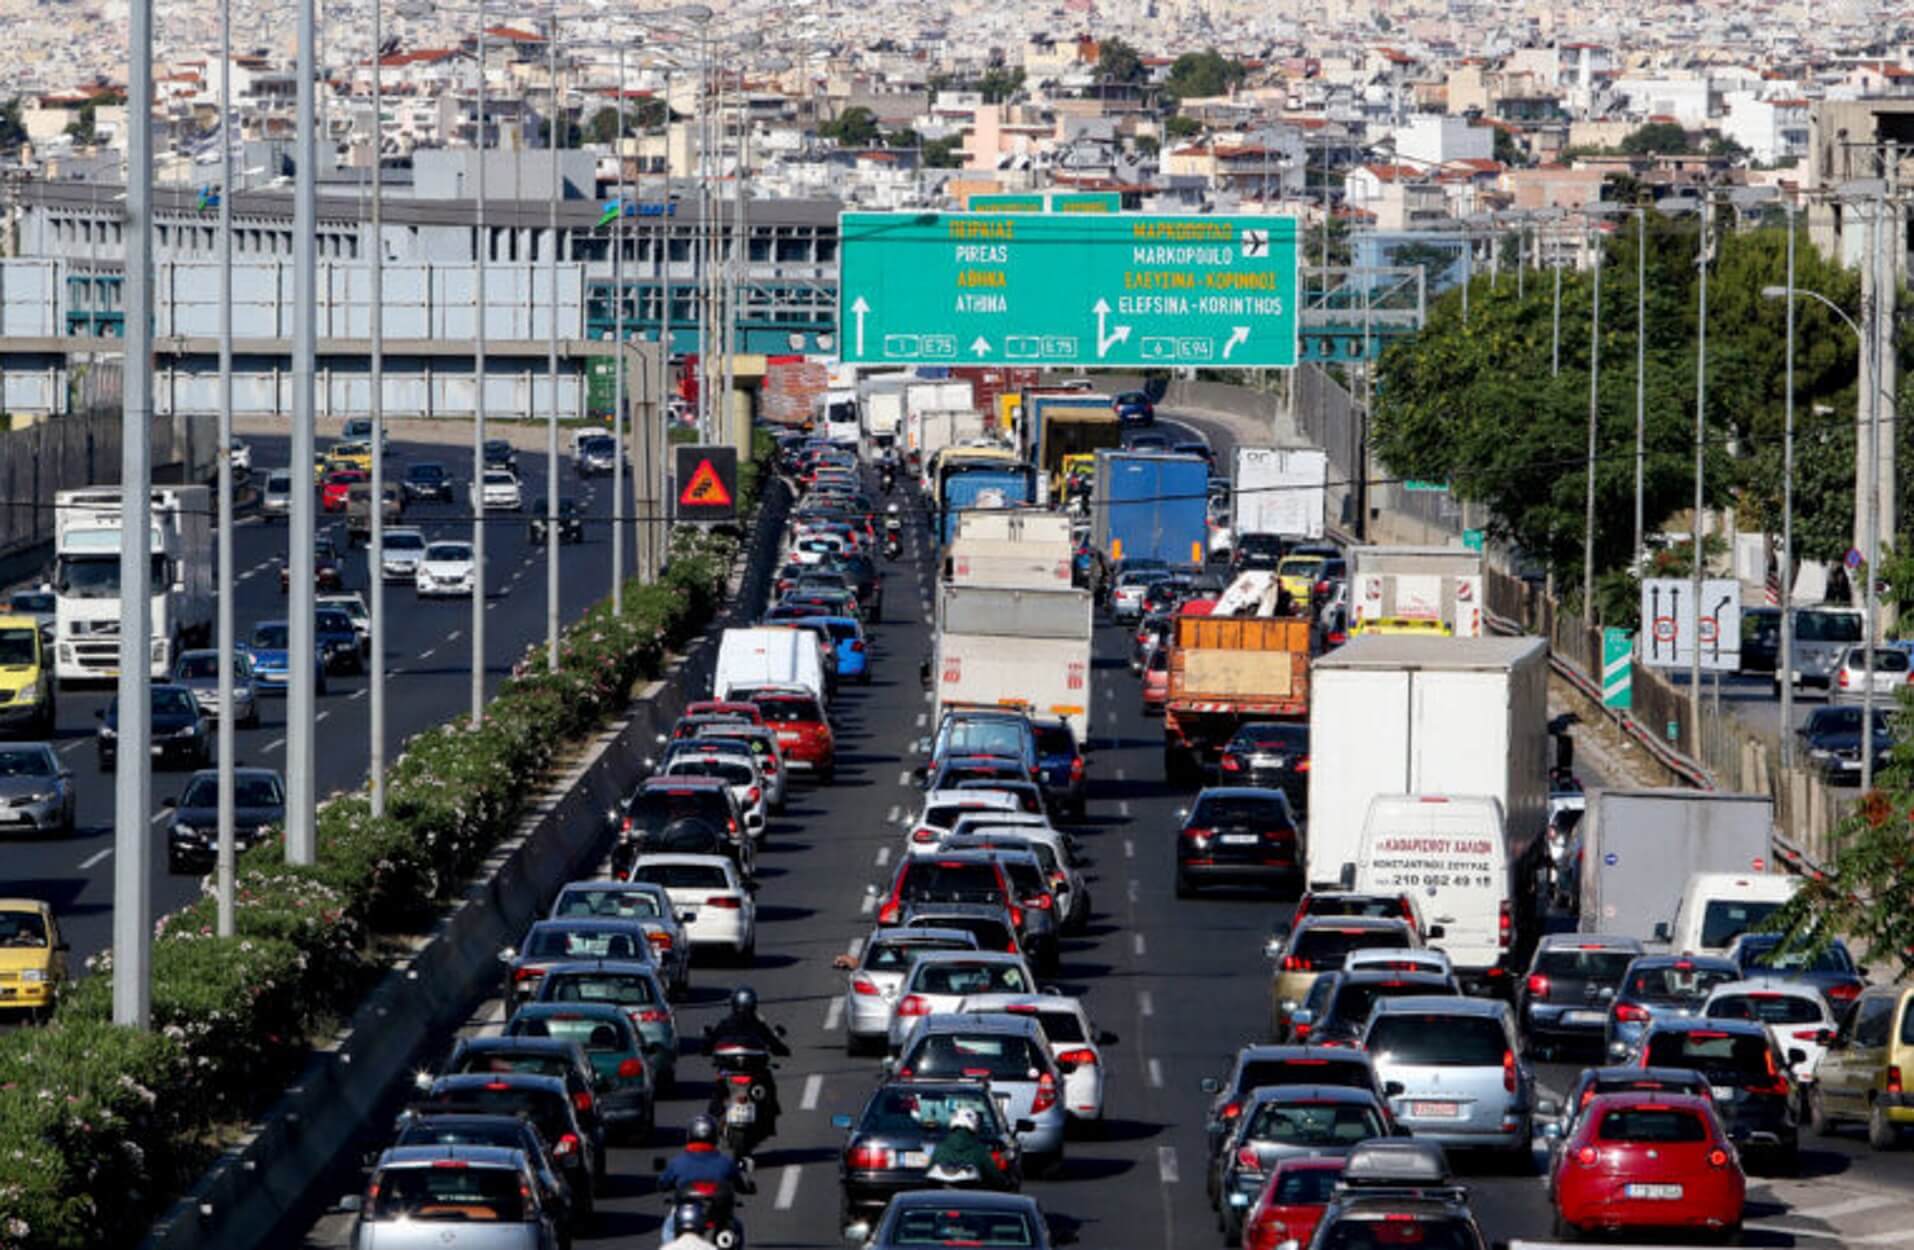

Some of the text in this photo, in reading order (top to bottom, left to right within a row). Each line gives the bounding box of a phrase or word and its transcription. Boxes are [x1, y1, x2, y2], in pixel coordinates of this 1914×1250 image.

[956, 245, 1008, 262] PIREAS
[1133, 246, 1233, 264] MARKOPOULO
[955, 294, 1007, 313] ATHINA
